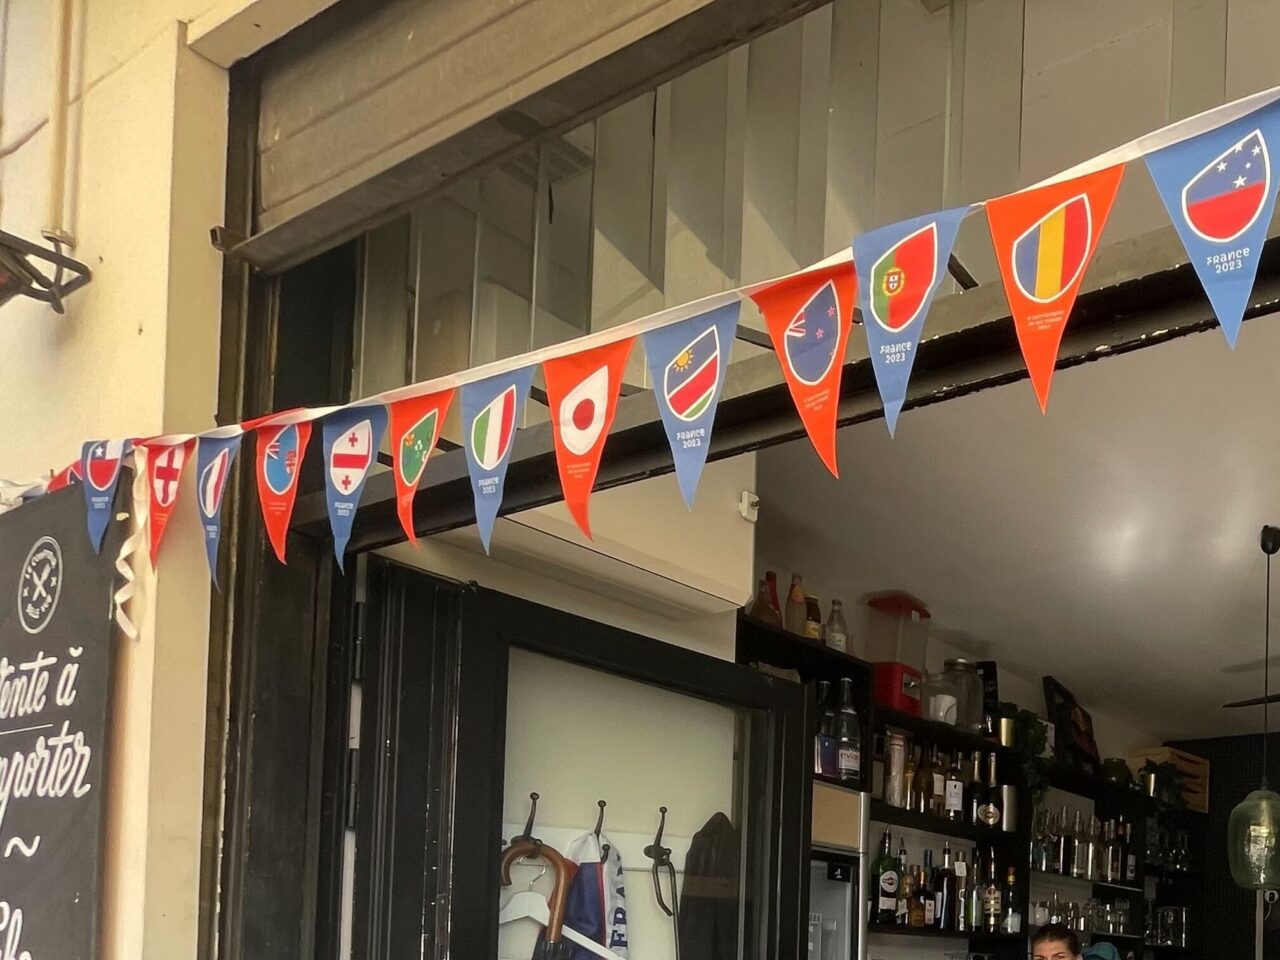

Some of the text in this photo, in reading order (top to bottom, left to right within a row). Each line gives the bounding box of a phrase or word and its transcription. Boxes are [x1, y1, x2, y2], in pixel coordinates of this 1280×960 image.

[1215, 259, 1243, 274] 2023
[885, 352, 906, 364] 2023
[0, 651, 58, 719] ente
